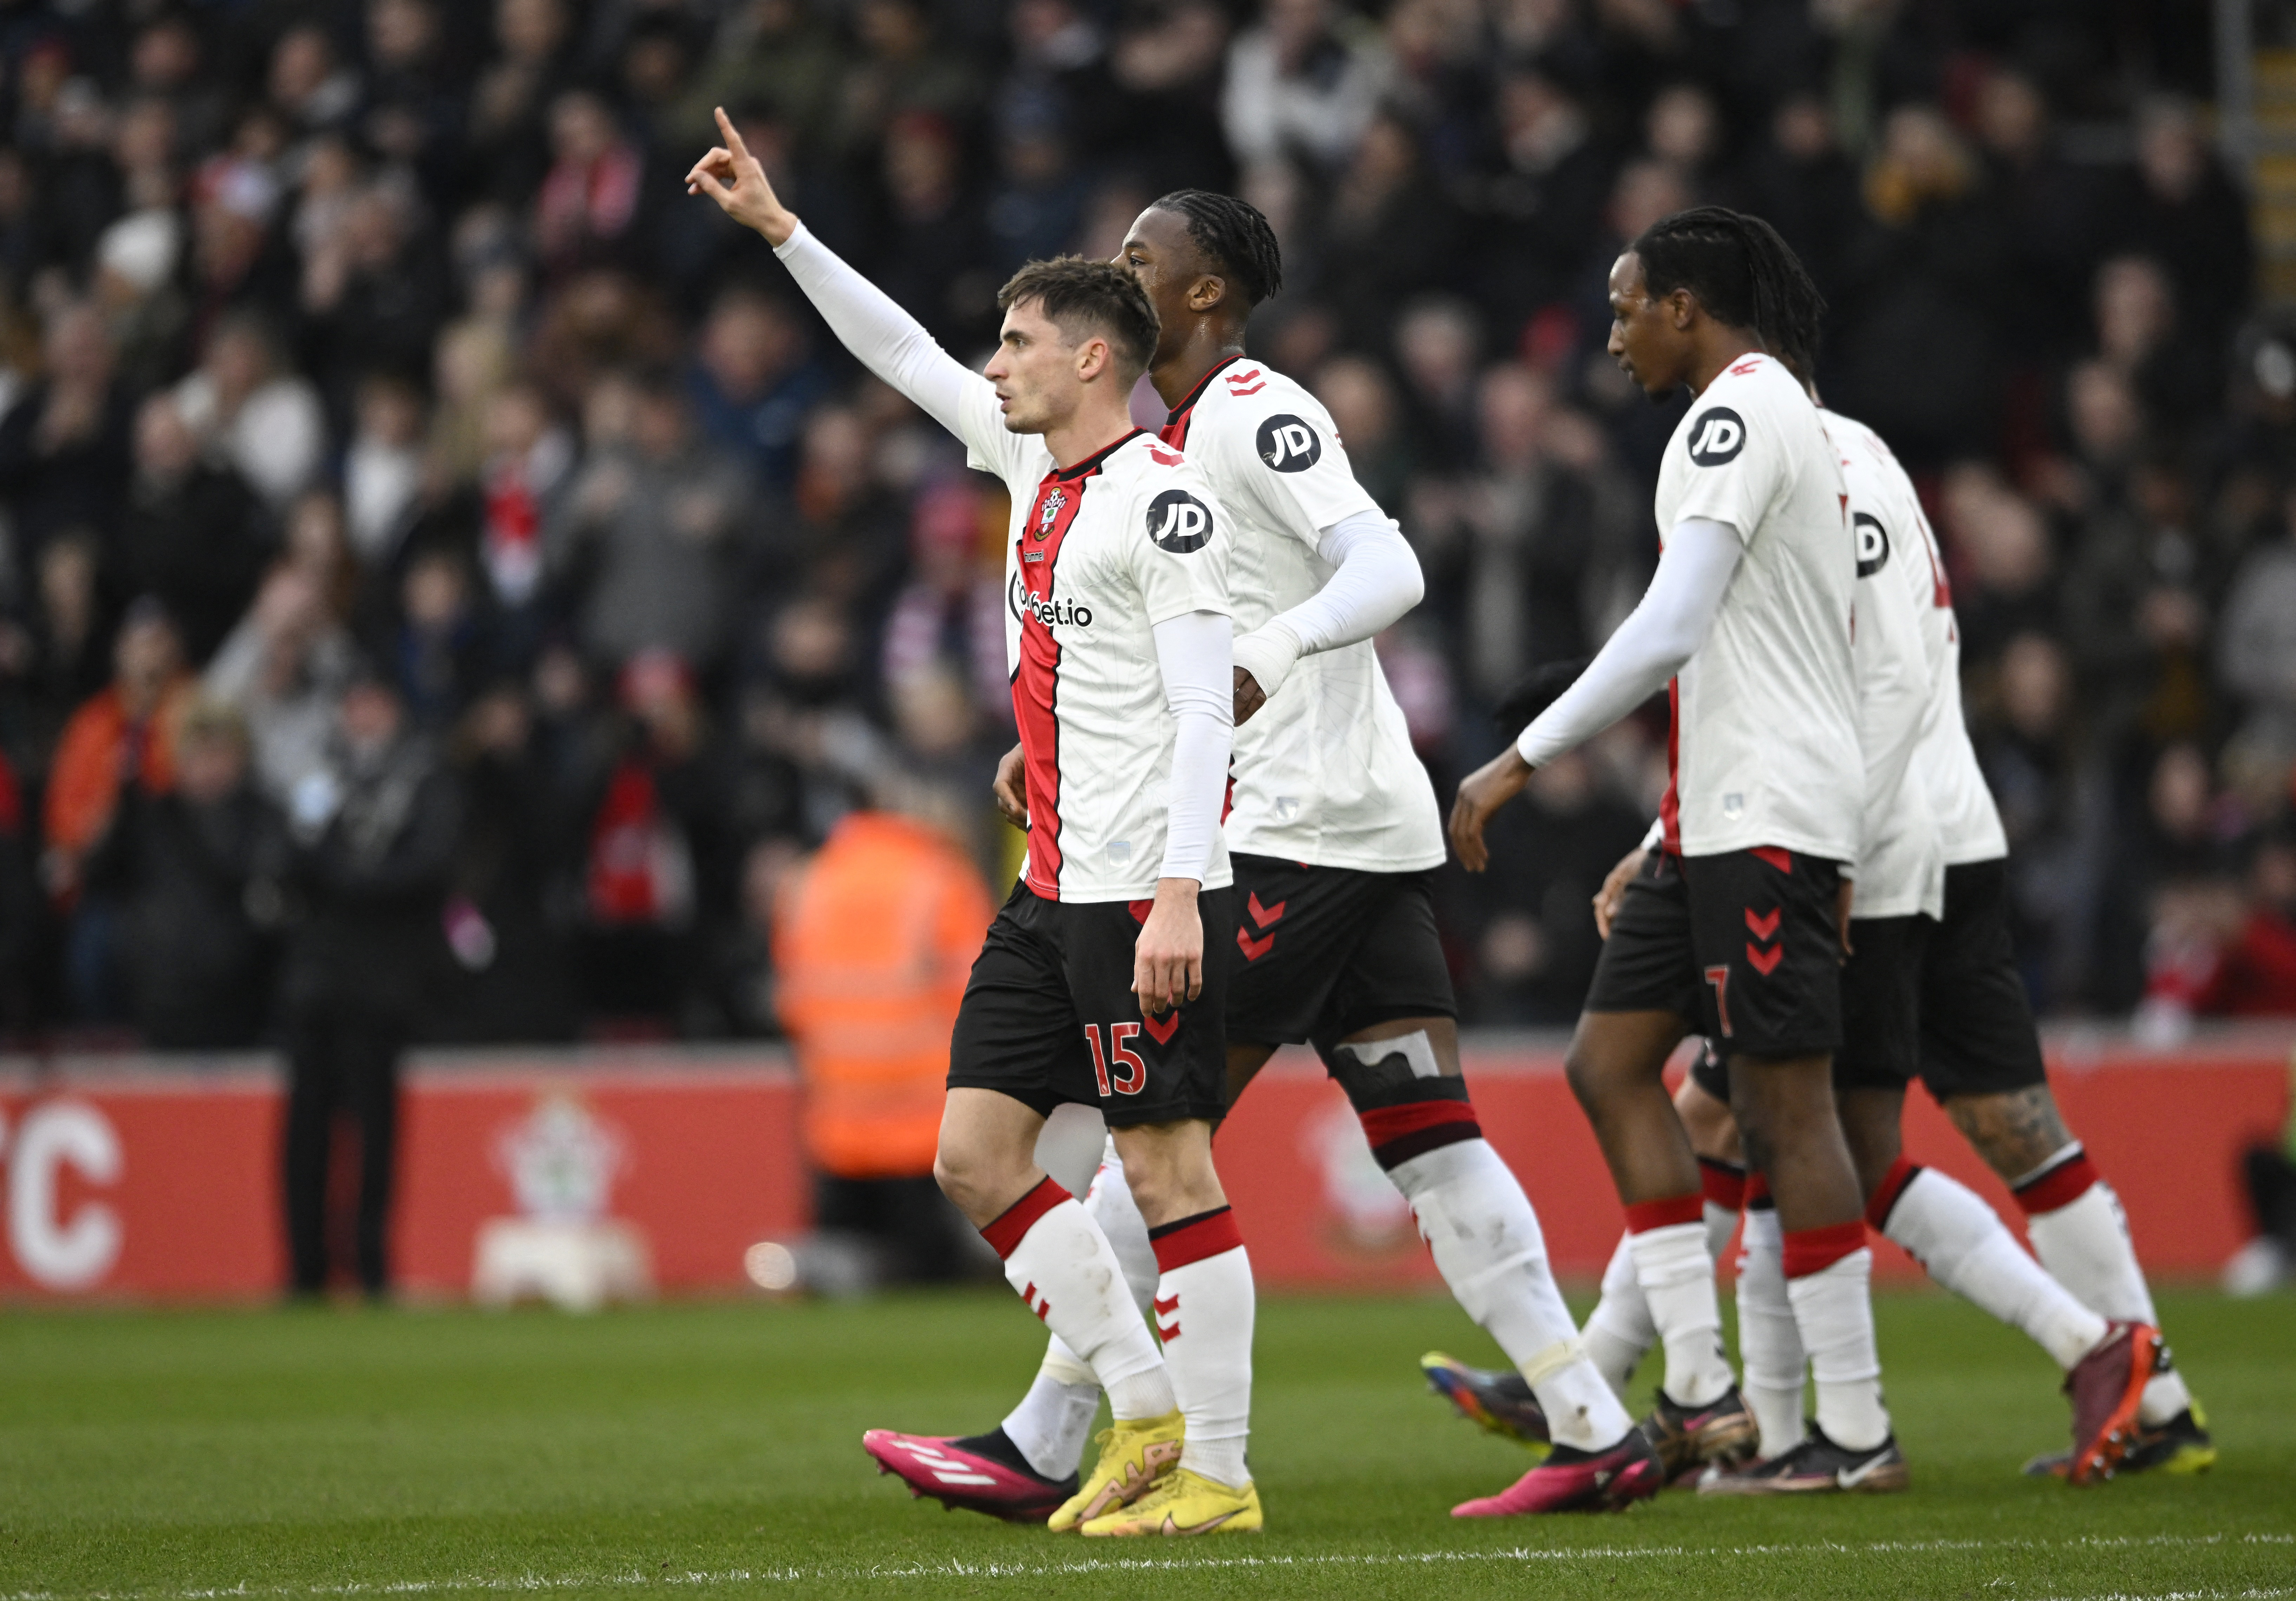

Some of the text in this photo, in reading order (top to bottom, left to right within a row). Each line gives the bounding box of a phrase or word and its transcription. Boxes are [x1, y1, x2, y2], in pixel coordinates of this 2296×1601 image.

[1271, 423, 1312, 467] JD
[1691, 419, 1741, 457] JD
[1156, 503, 1206, 540] JD
[1024, 549, 1044, 562] hummel
[1855, 524, 1883, 562] D
[1705, 963, 1733, 1037] 7
[1085, 1022, 1146, 1096] 15
[0, 1100, 123, 1291] C
